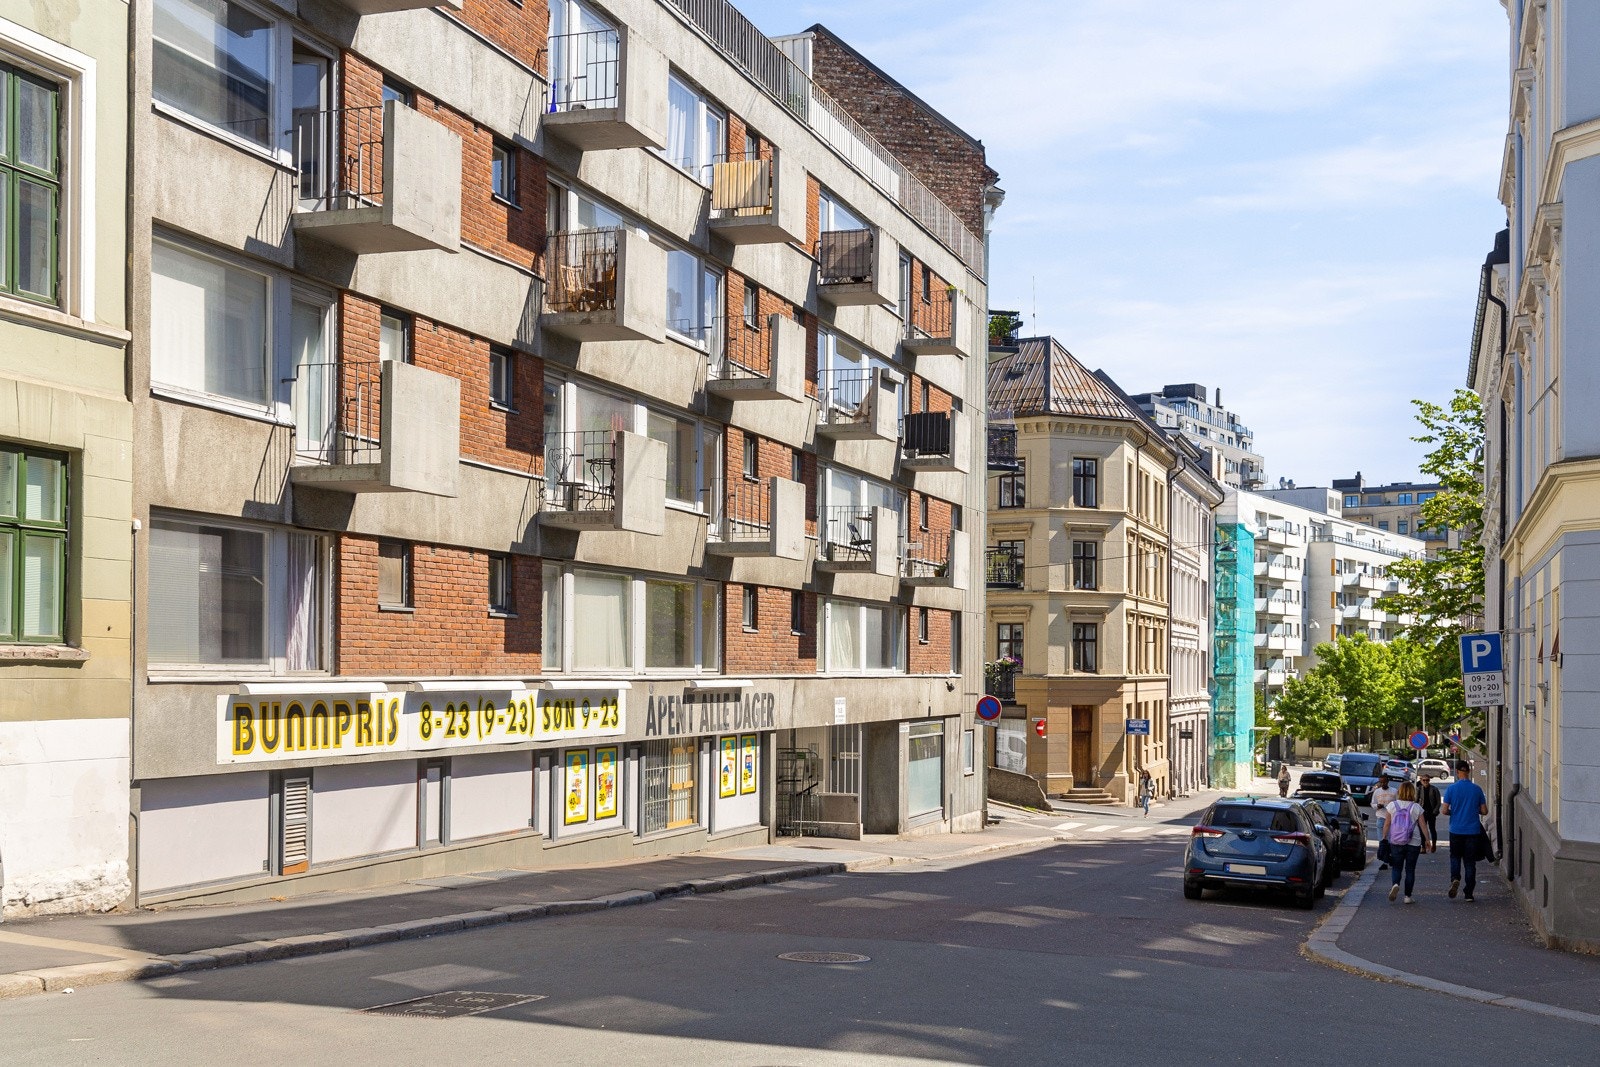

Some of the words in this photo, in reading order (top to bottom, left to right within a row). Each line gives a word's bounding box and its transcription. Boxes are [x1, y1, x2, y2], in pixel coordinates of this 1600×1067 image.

[1471, 639, 1492, 668] P
[1469, 683, 1500, 692] (09-20)
[1471, 674, 1496, 683] 09-20
[232, 697, 399, 755] BUNNPRIS
[419, 700, 470, 741] 8-23
[477, 693, 535, 742] (9-23)
[542, 697, 576, 733] SØN
[581, 696, 619, 730] 9-23
[645, 683, 695, 736] ÅPENT
[699, 693, 730, 733] ALLE
[734, 692, 775, 730] DAGER
